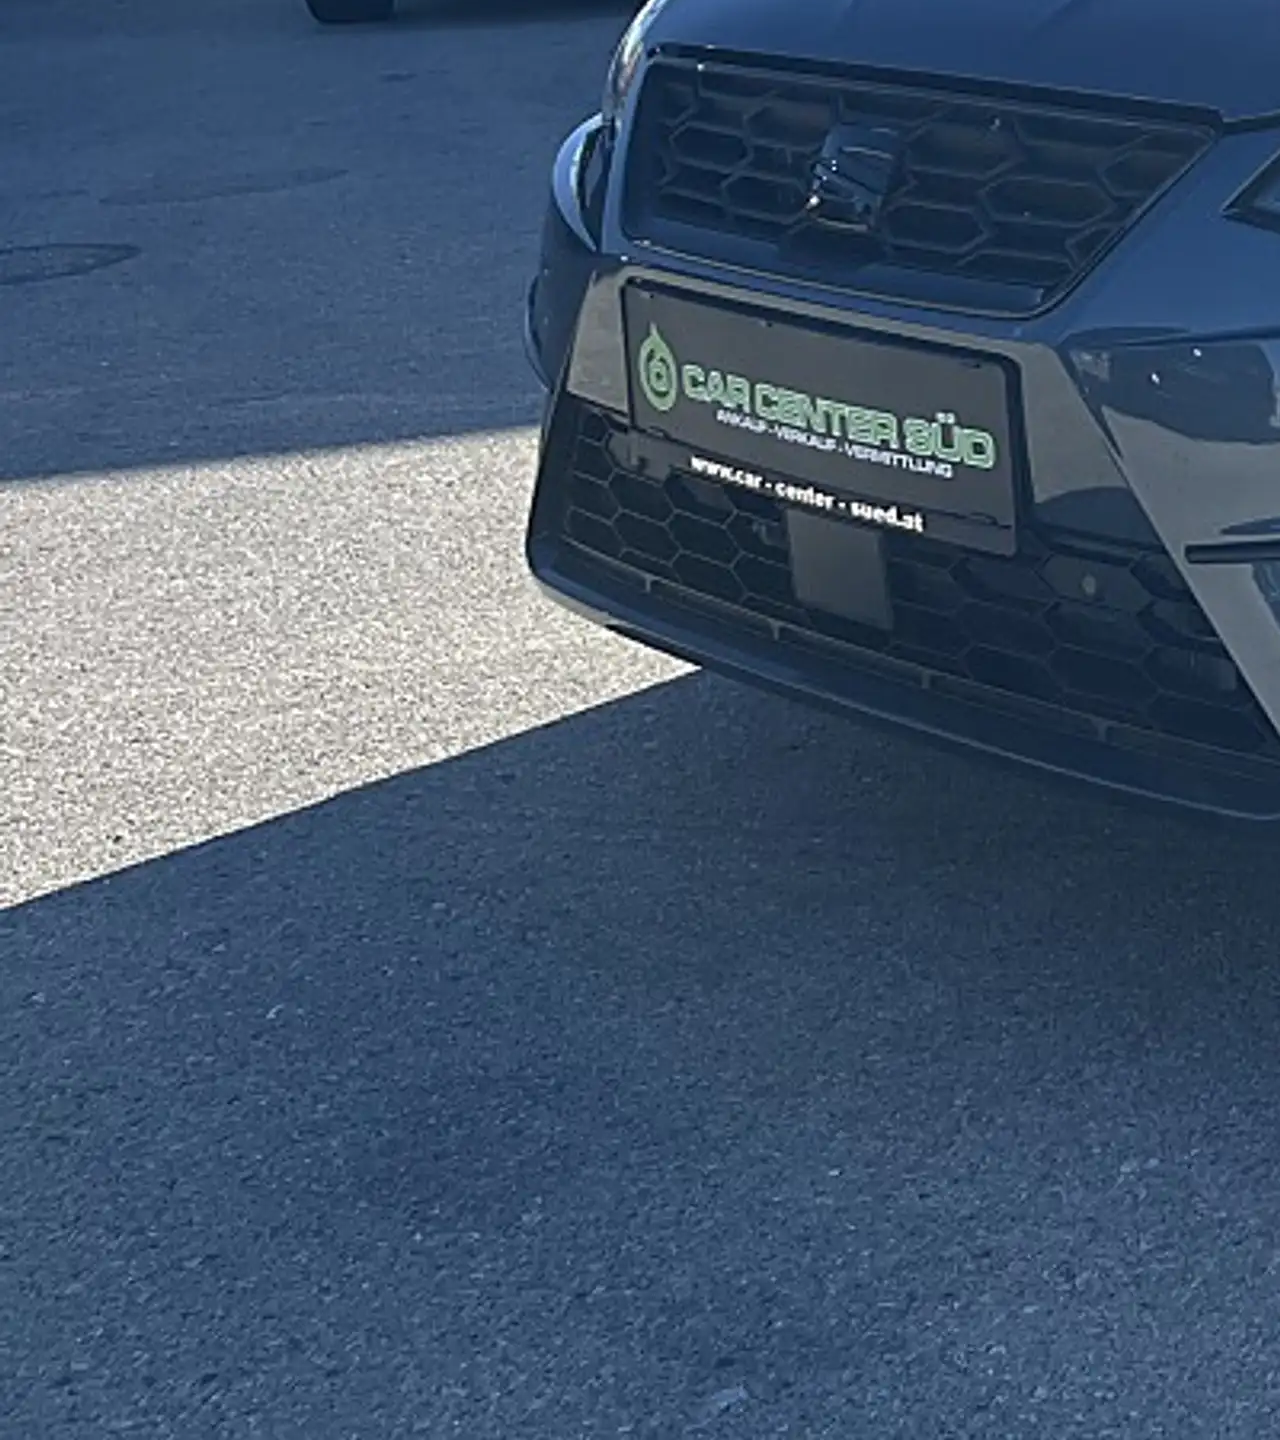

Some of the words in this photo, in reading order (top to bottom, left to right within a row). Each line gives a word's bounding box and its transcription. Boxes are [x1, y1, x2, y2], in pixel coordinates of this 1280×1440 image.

[682, 363, 750, 413] CAR
[755, 382, 898, 449] CENTER
[905, 412, 995, 469] SÜD
